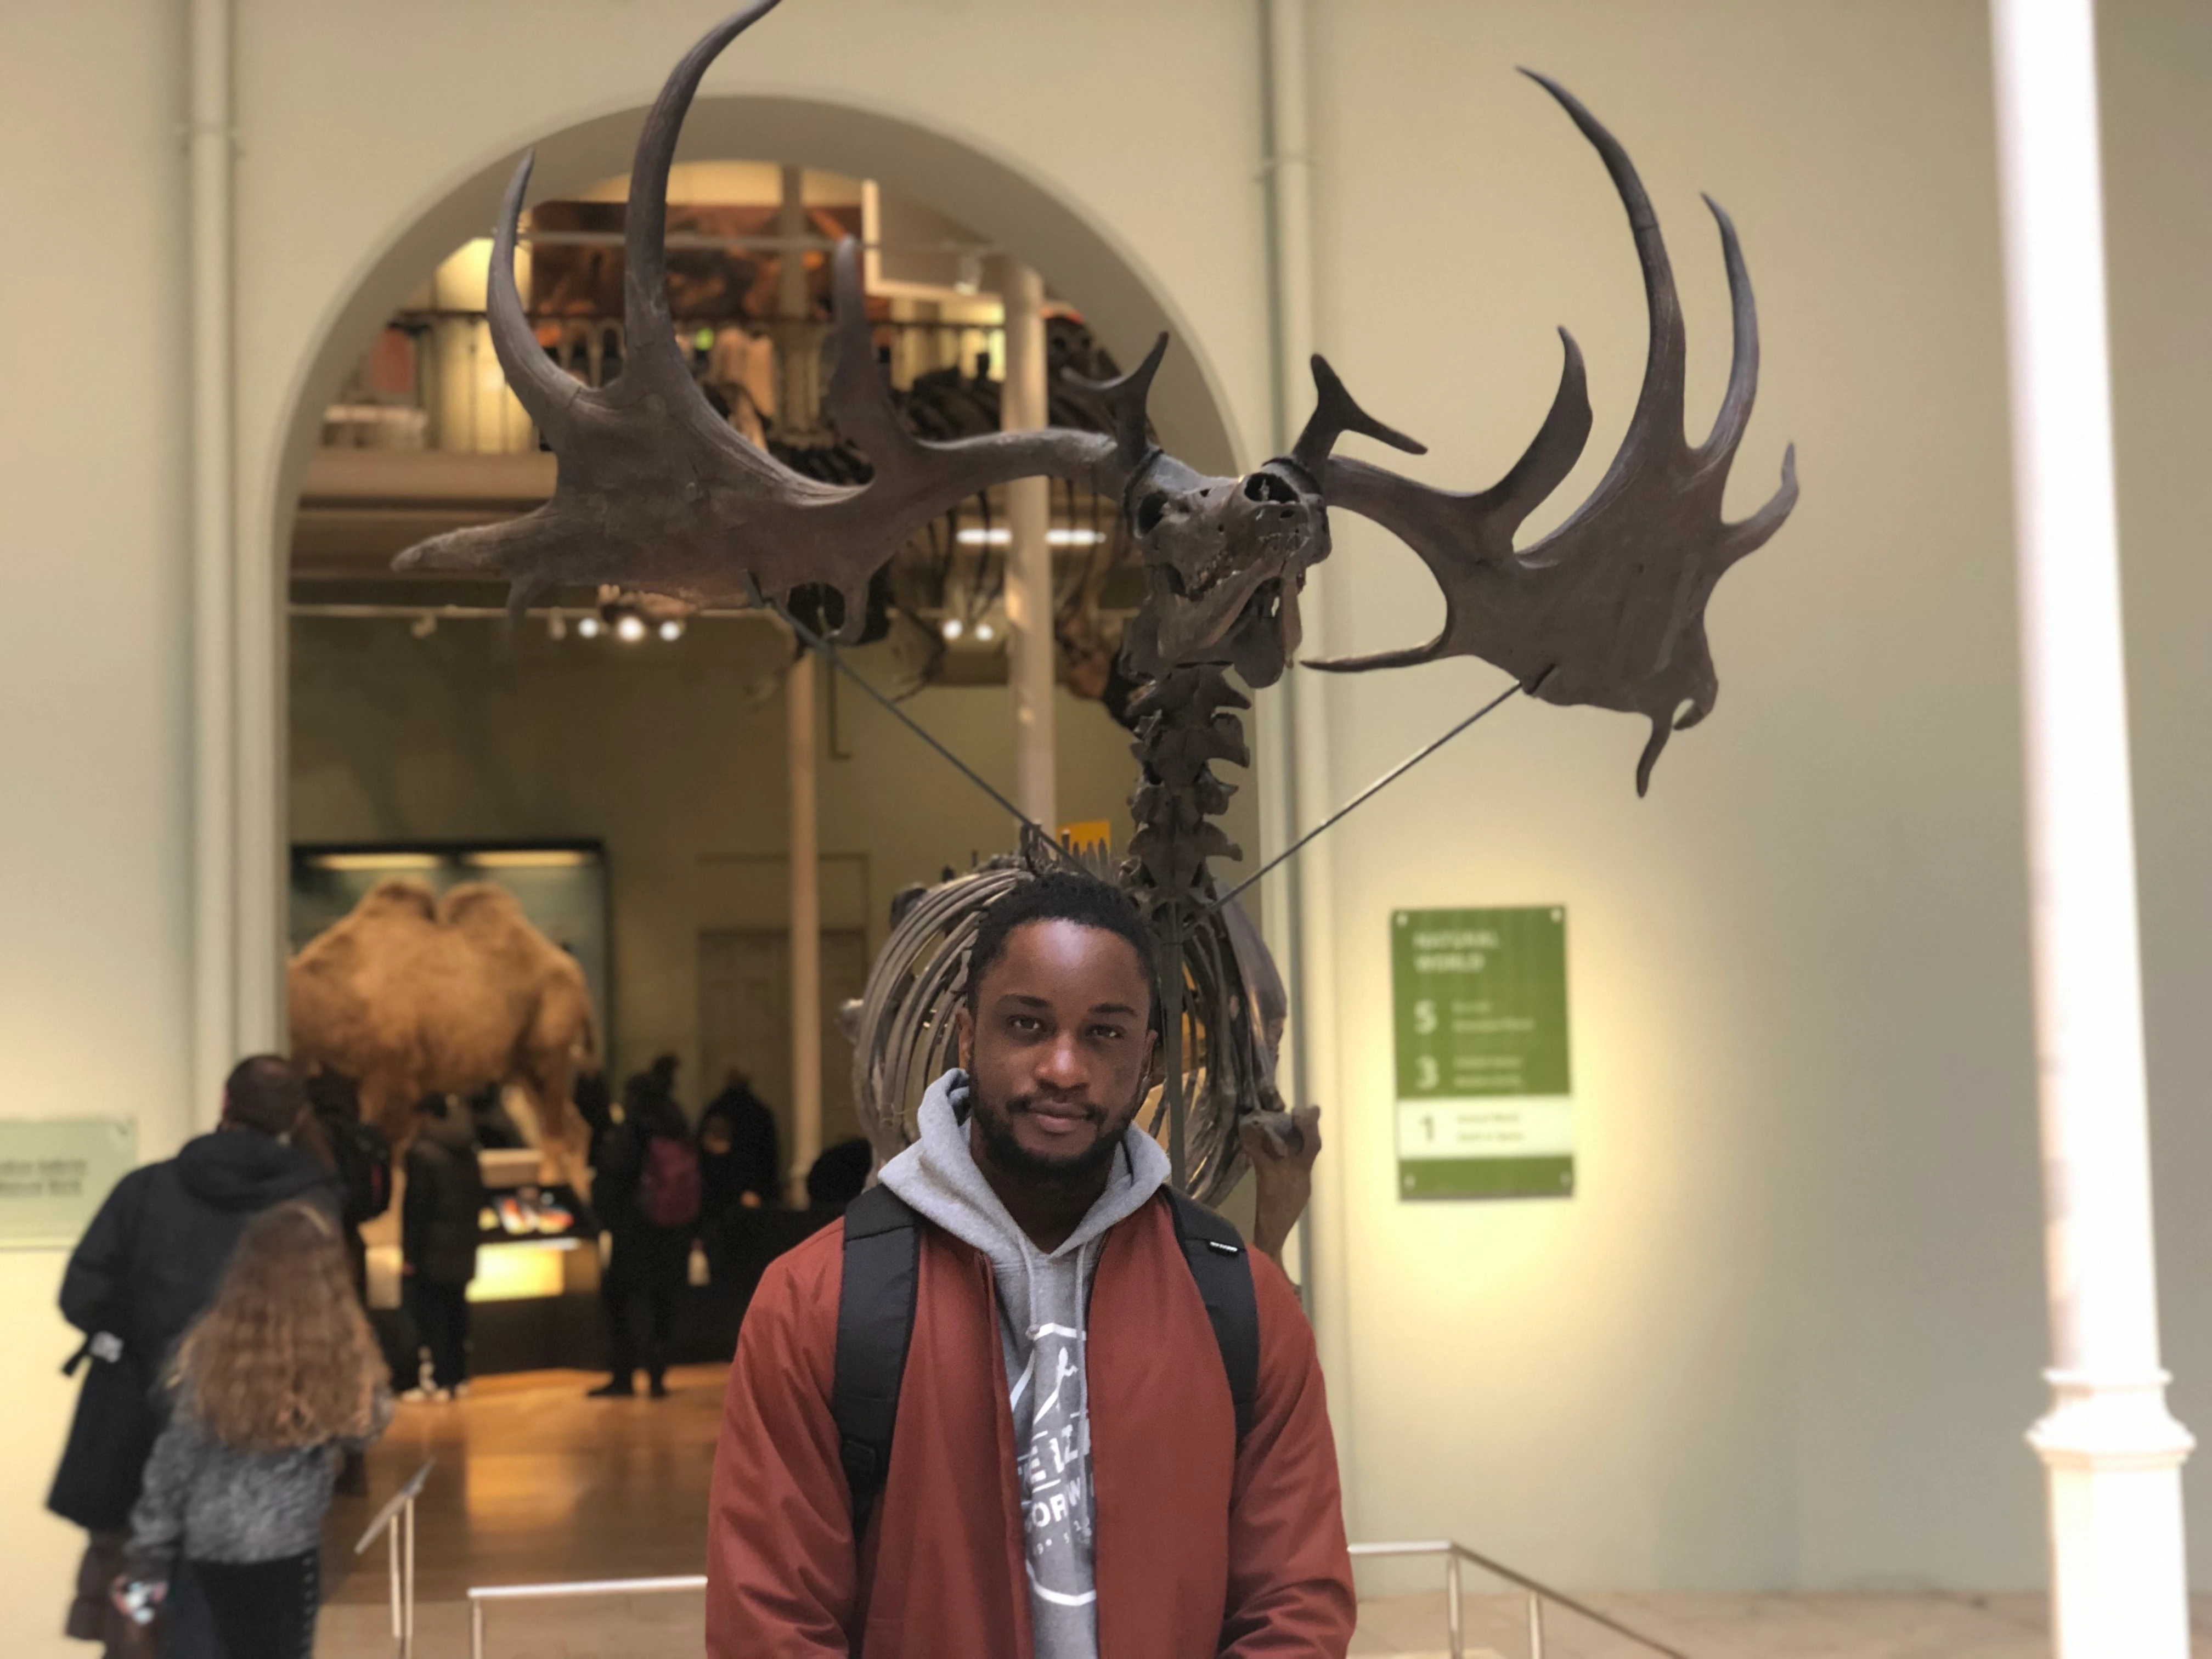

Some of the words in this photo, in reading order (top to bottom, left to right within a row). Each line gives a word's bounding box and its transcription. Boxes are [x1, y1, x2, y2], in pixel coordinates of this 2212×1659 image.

[1415, 952, 1485, 972] WORLD
[1414, 1000, 1437, 1034] 5
[1415, 1056, 1439, 1090] 3
[1420, 1114, 1434, 1142] 1
